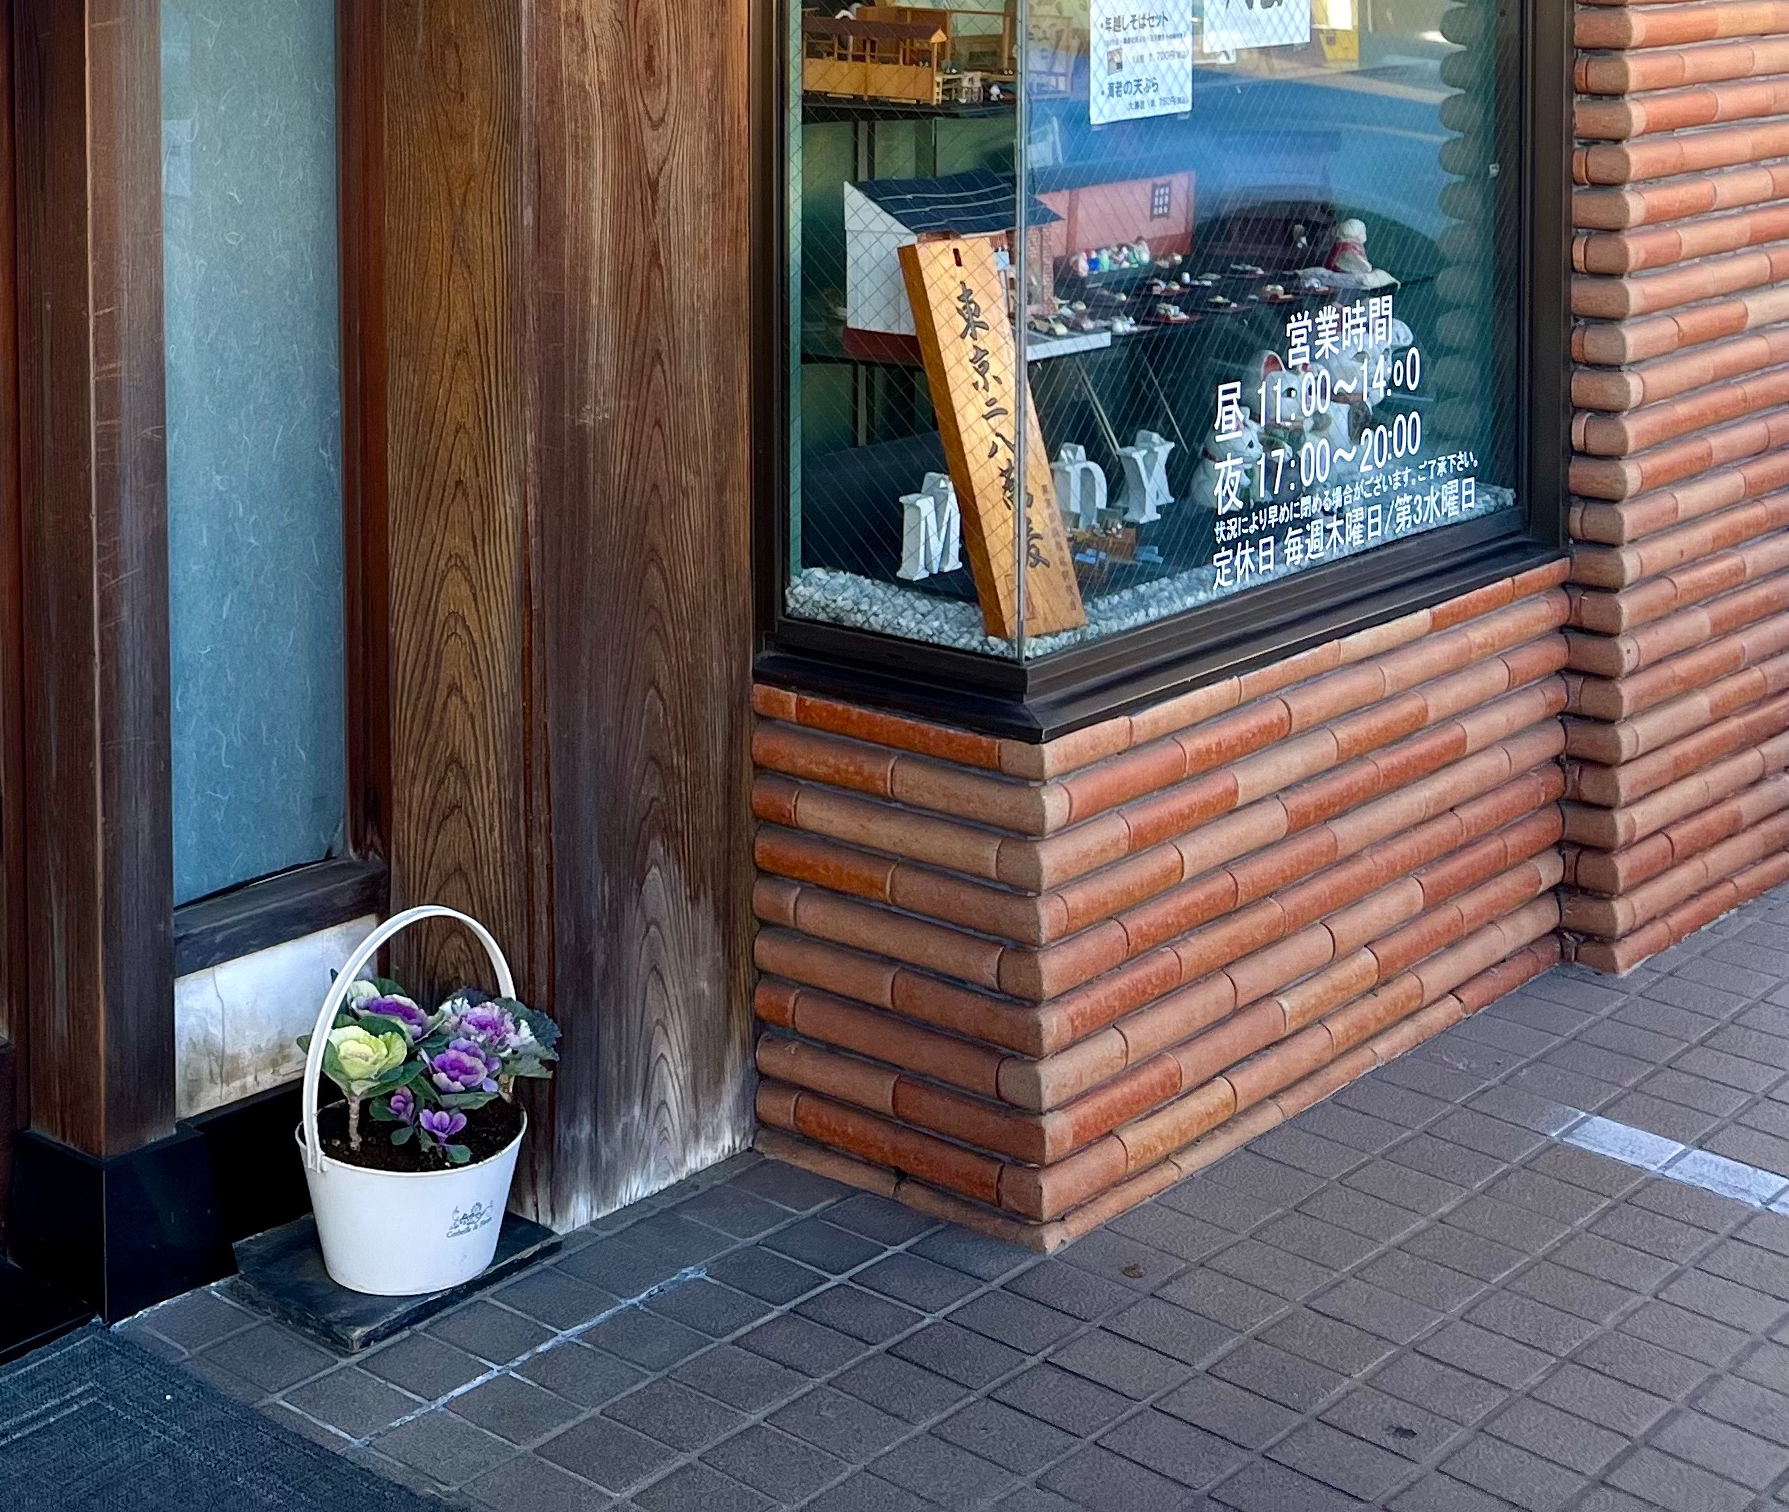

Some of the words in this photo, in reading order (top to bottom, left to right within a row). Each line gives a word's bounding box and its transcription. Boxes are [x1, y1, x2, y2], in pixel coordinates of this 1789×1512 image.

[1285, 294, 1394, 369] 営業時間
[1213, 380, 1245, 443] 昼
[1212, 452, 1244, 516] 夜
[1211, 536, 1275, 591] 定休日
